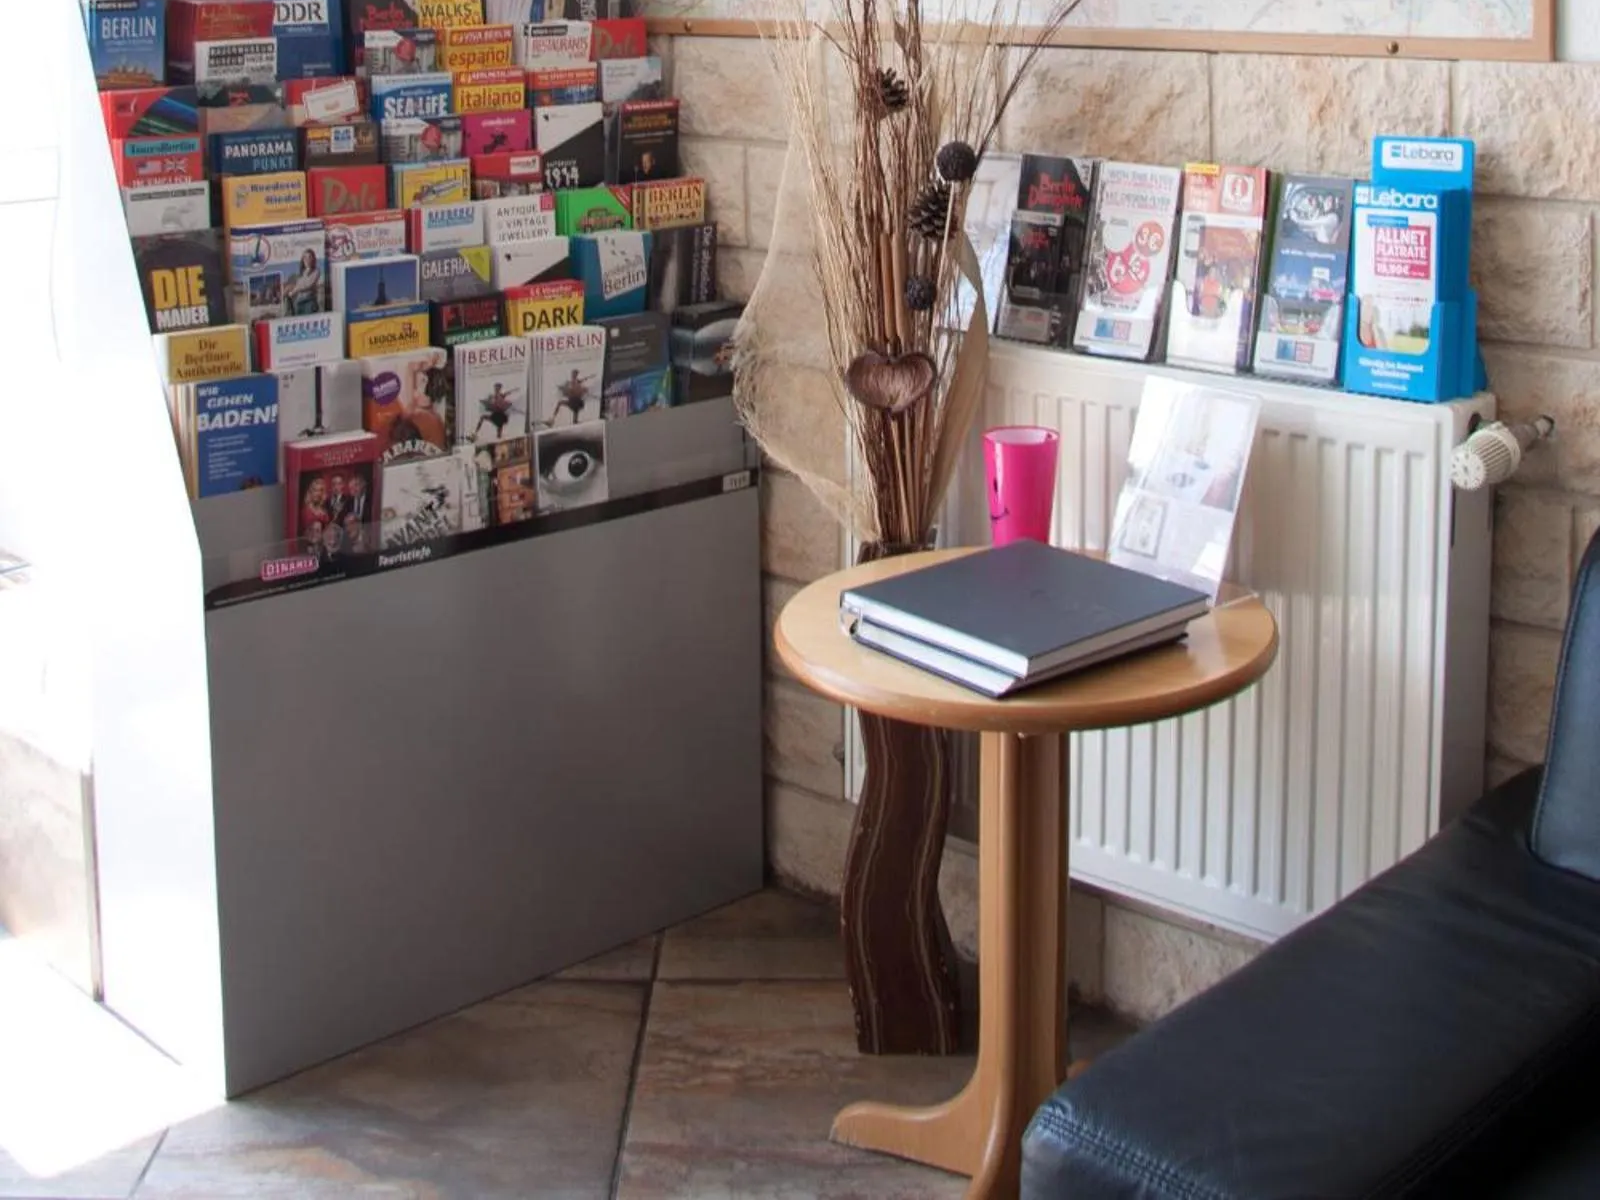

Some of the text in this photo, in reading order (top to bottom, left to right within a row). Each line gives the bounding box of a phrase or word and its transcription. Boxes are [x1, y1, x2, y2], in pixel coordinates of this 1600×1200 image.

[276, 2, 323, 22] DDR
[420, 3, 472, 17] WALKS
[101, 15, 157, 39] BERLIN
[448, 45, 510, 69] español
[384, 97, 416, 118] SEA
[459, 87, 522, 109] italiano
[224, 140, 294, 159] PANORAMA
[1402, 145, 1454, 162] Lebara
[252, 157, 293, 171] PUNKT
[651, 184, 702, 203] BERLIN
[1371, 187, 1438, 209] Lebara
[497, 204, 538, 218] ANTIQUE
[506, 215, 548, 229] VINTAGE
[498, 229, 549, 243] JEWELLERY
[1376, 227, 1428, 247] ALLNET
[1376, 243, 1428, 260] FLATRATE
[422, 256, 472, 280] GALERIA
[152, 266, 206, 309] DIE
[603, 270, 646, 293] Berlin
[156, 306, 209, 330] MAUER
[522, 304, 579, 331] DARK
[198, 339, 217, 351] Die
[368, 331, 420, 346] LEGOLAND
[544, 332, 603, 352] BERLIN
[185, 350, 232, 366] Berliner
[468, 345, 526, 365] BERLIN
[198, 386, 220, 397] WIR
[207, 393, 254, 409] GEHEN
[197, 403, 279, 432] BADEN!
